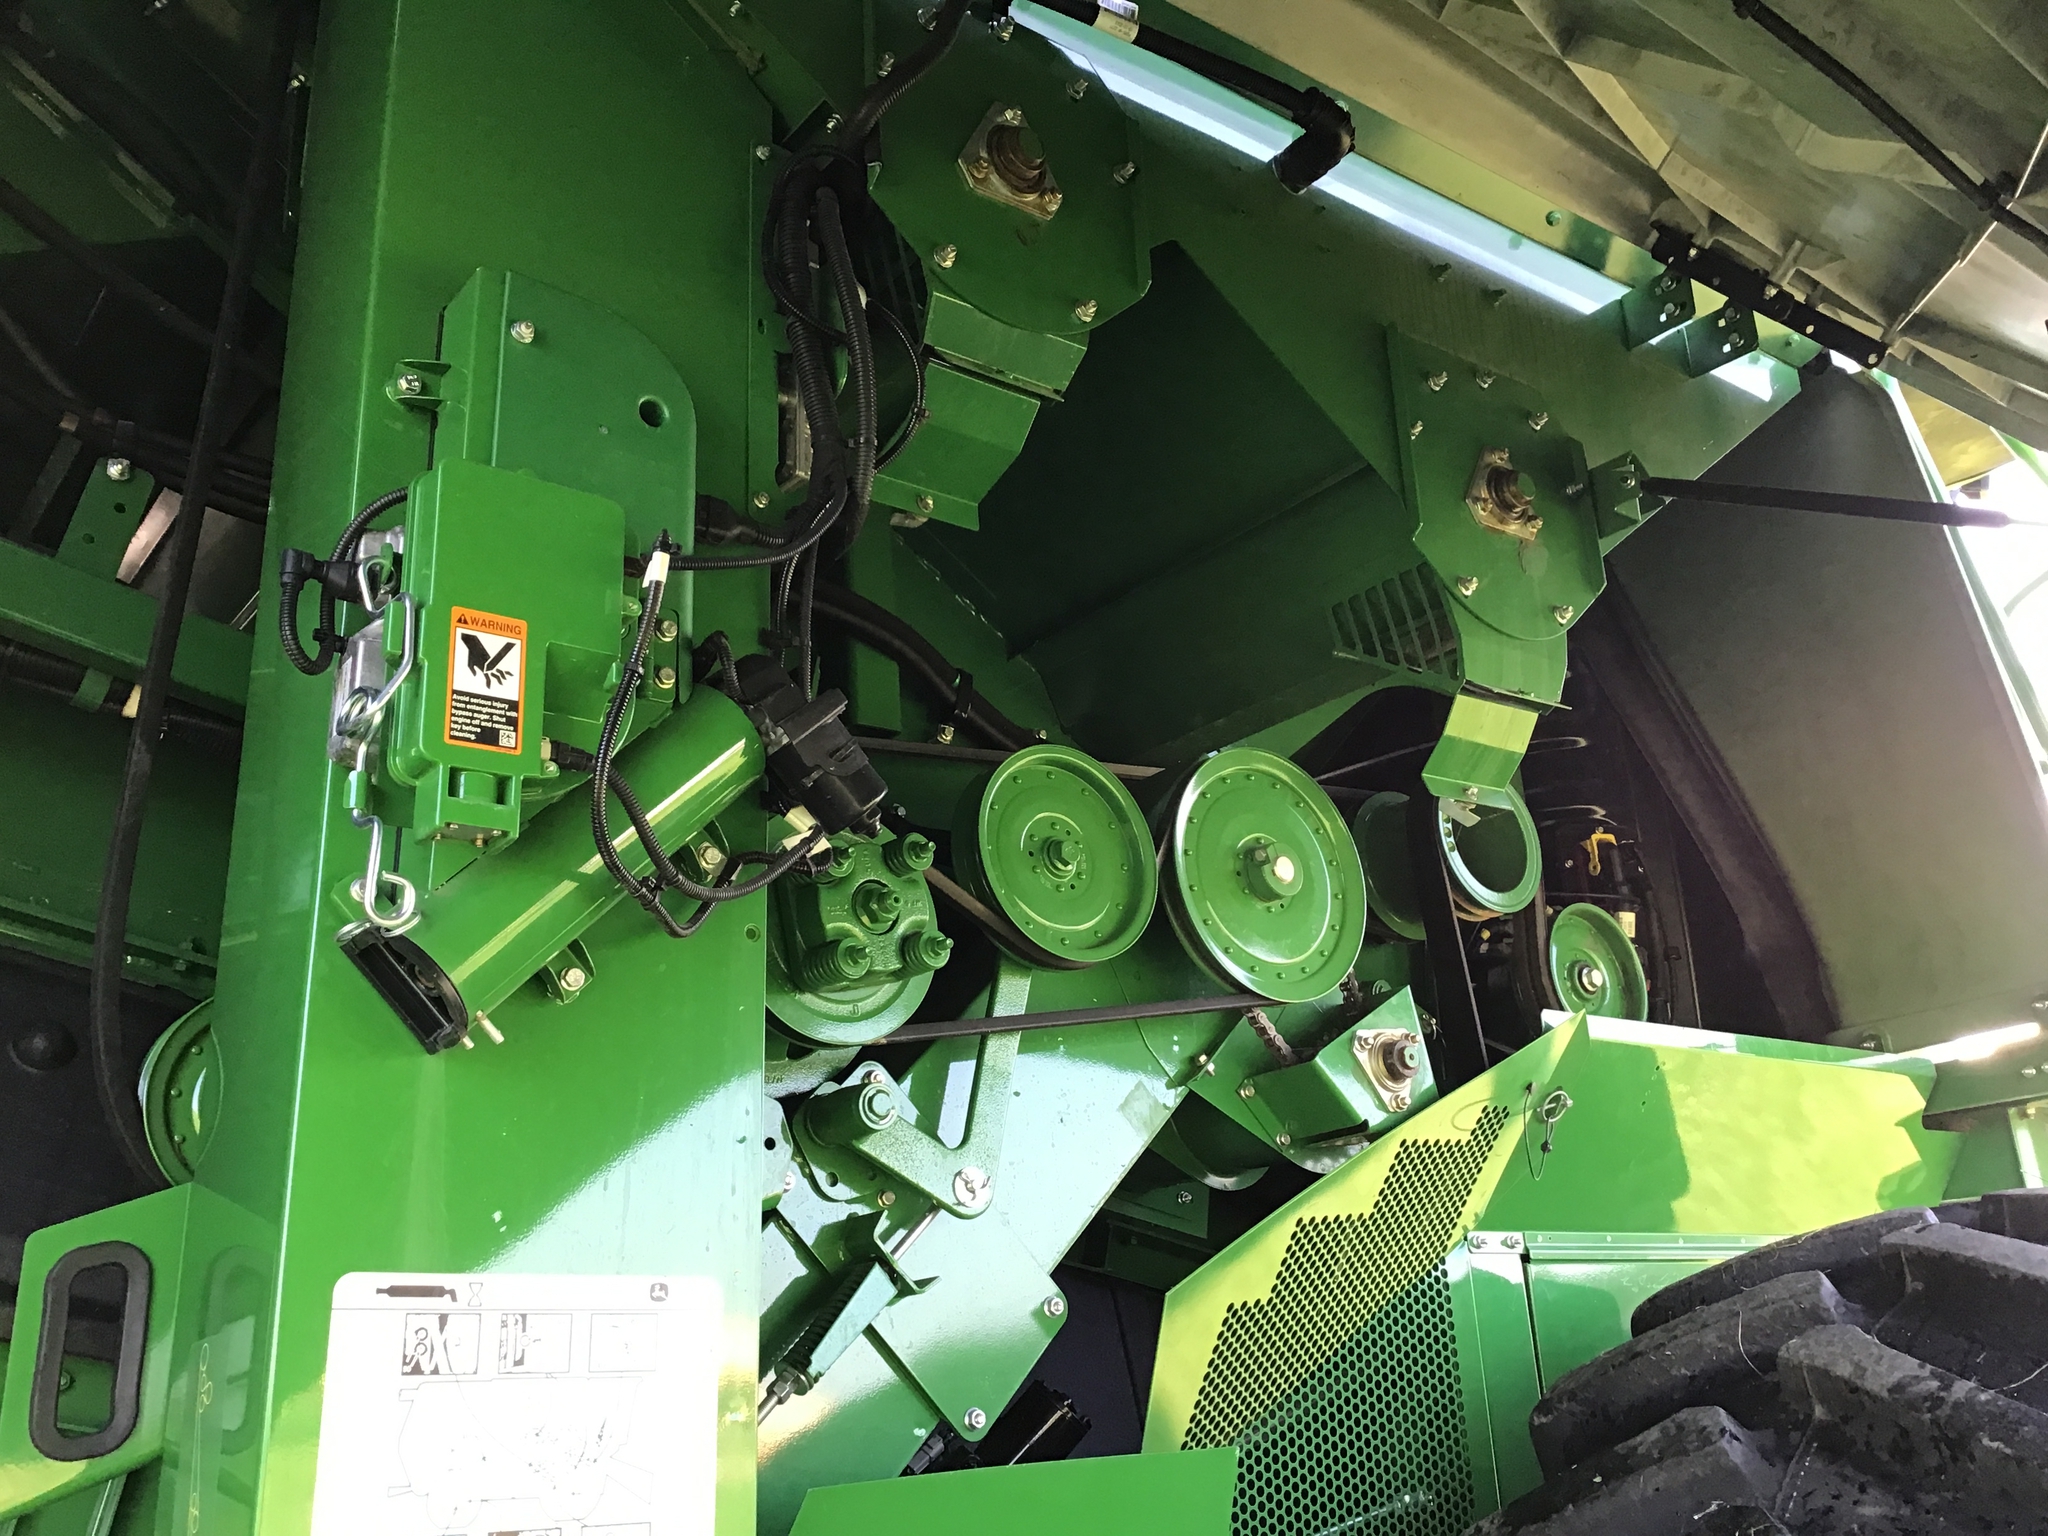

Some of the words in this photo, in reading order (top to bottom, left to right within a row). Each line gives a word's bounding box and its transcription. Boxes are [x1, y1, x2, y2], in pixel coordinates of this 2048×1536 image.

[470, 616, 522, 635] WARNING
[452, 694, 469, 702] Avoid
[470, 697, 491, 705] serious
[492, 701, 509, 710] injury
[452, 700, 466, 708] from
[466, 704, 505, 715] entanglement
[451, 708, 472, 717] bypass
[473, 712, 491, 720] auger.
[450, 722, 461, 731] key
[462, 724, 481, 733] before
[451, 716, 471, 724] engine
[492, 723, 514, 731] remove
[450, 730, 477, 740] cleaning.
